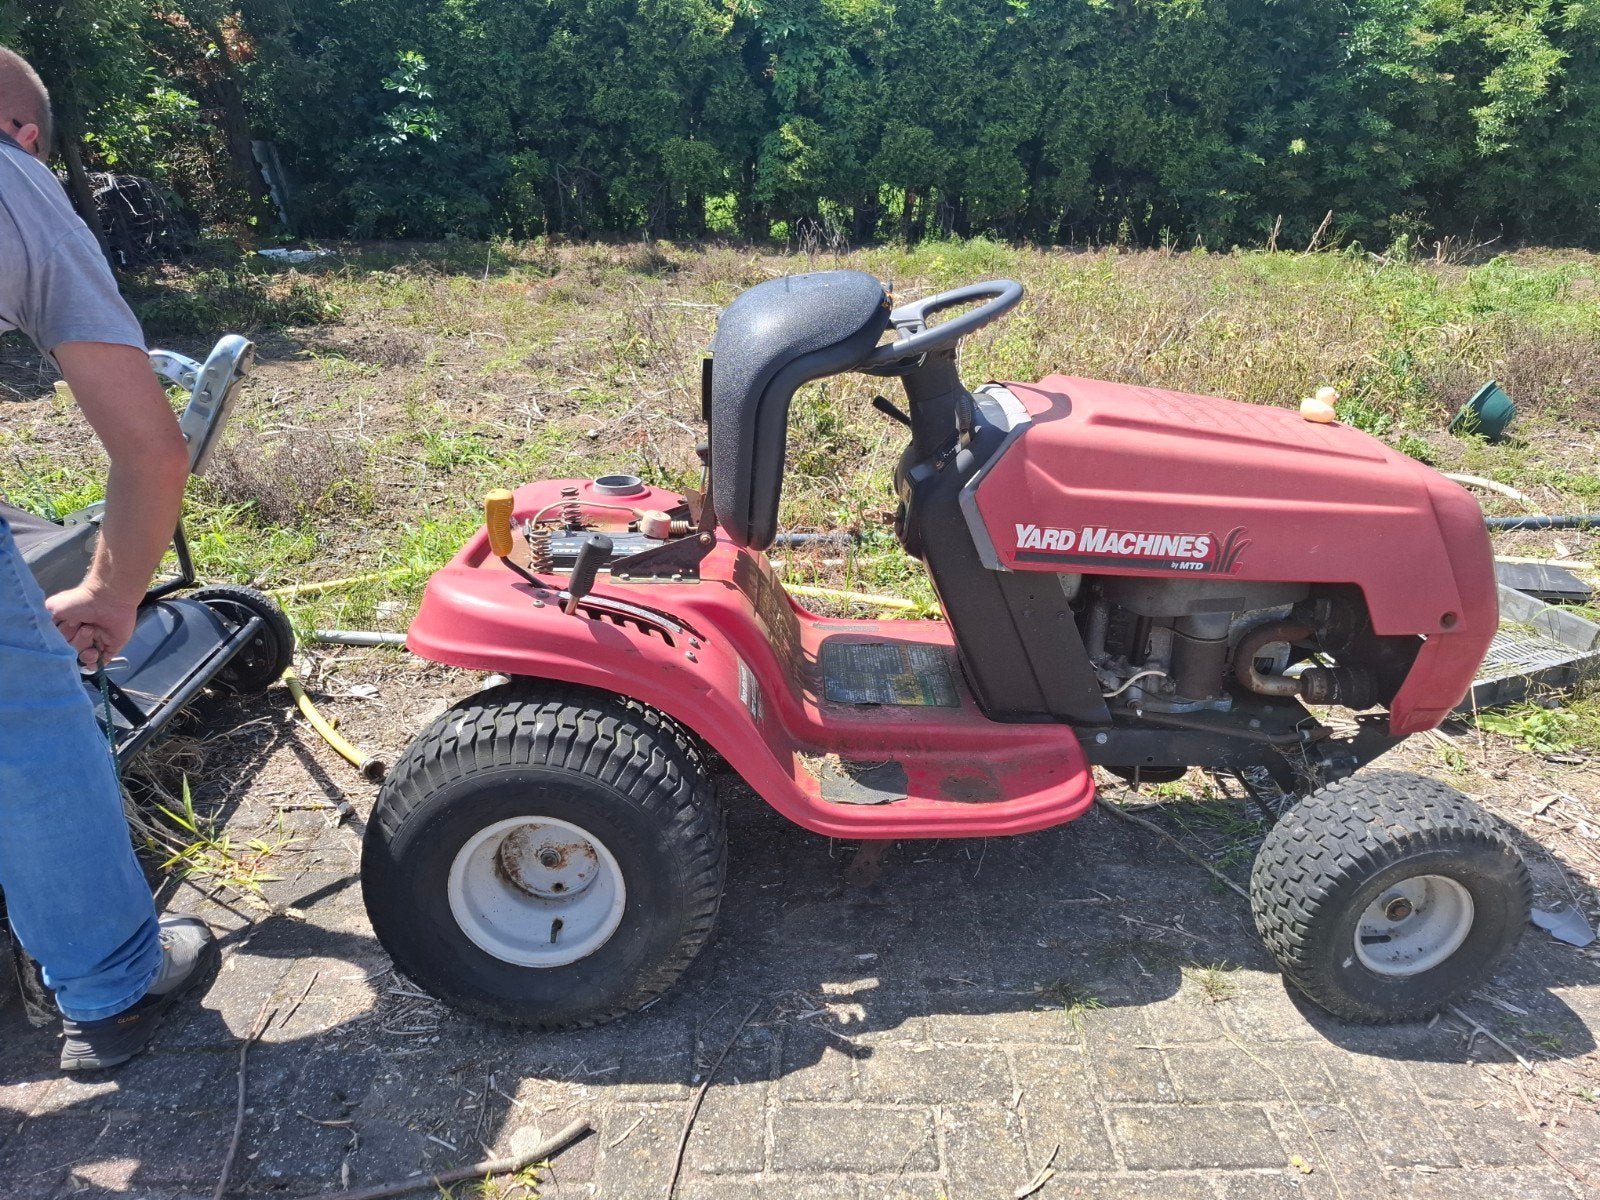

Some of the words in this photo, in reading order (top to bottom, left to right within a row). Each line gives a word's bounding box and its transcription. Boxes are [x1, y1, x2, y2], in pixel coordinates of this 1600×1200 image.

[1015, 523, 1076, 551] YARD
[1078, 527, 1211, 559] MACHINES
[1179, 561, 1204, 570] MTD
